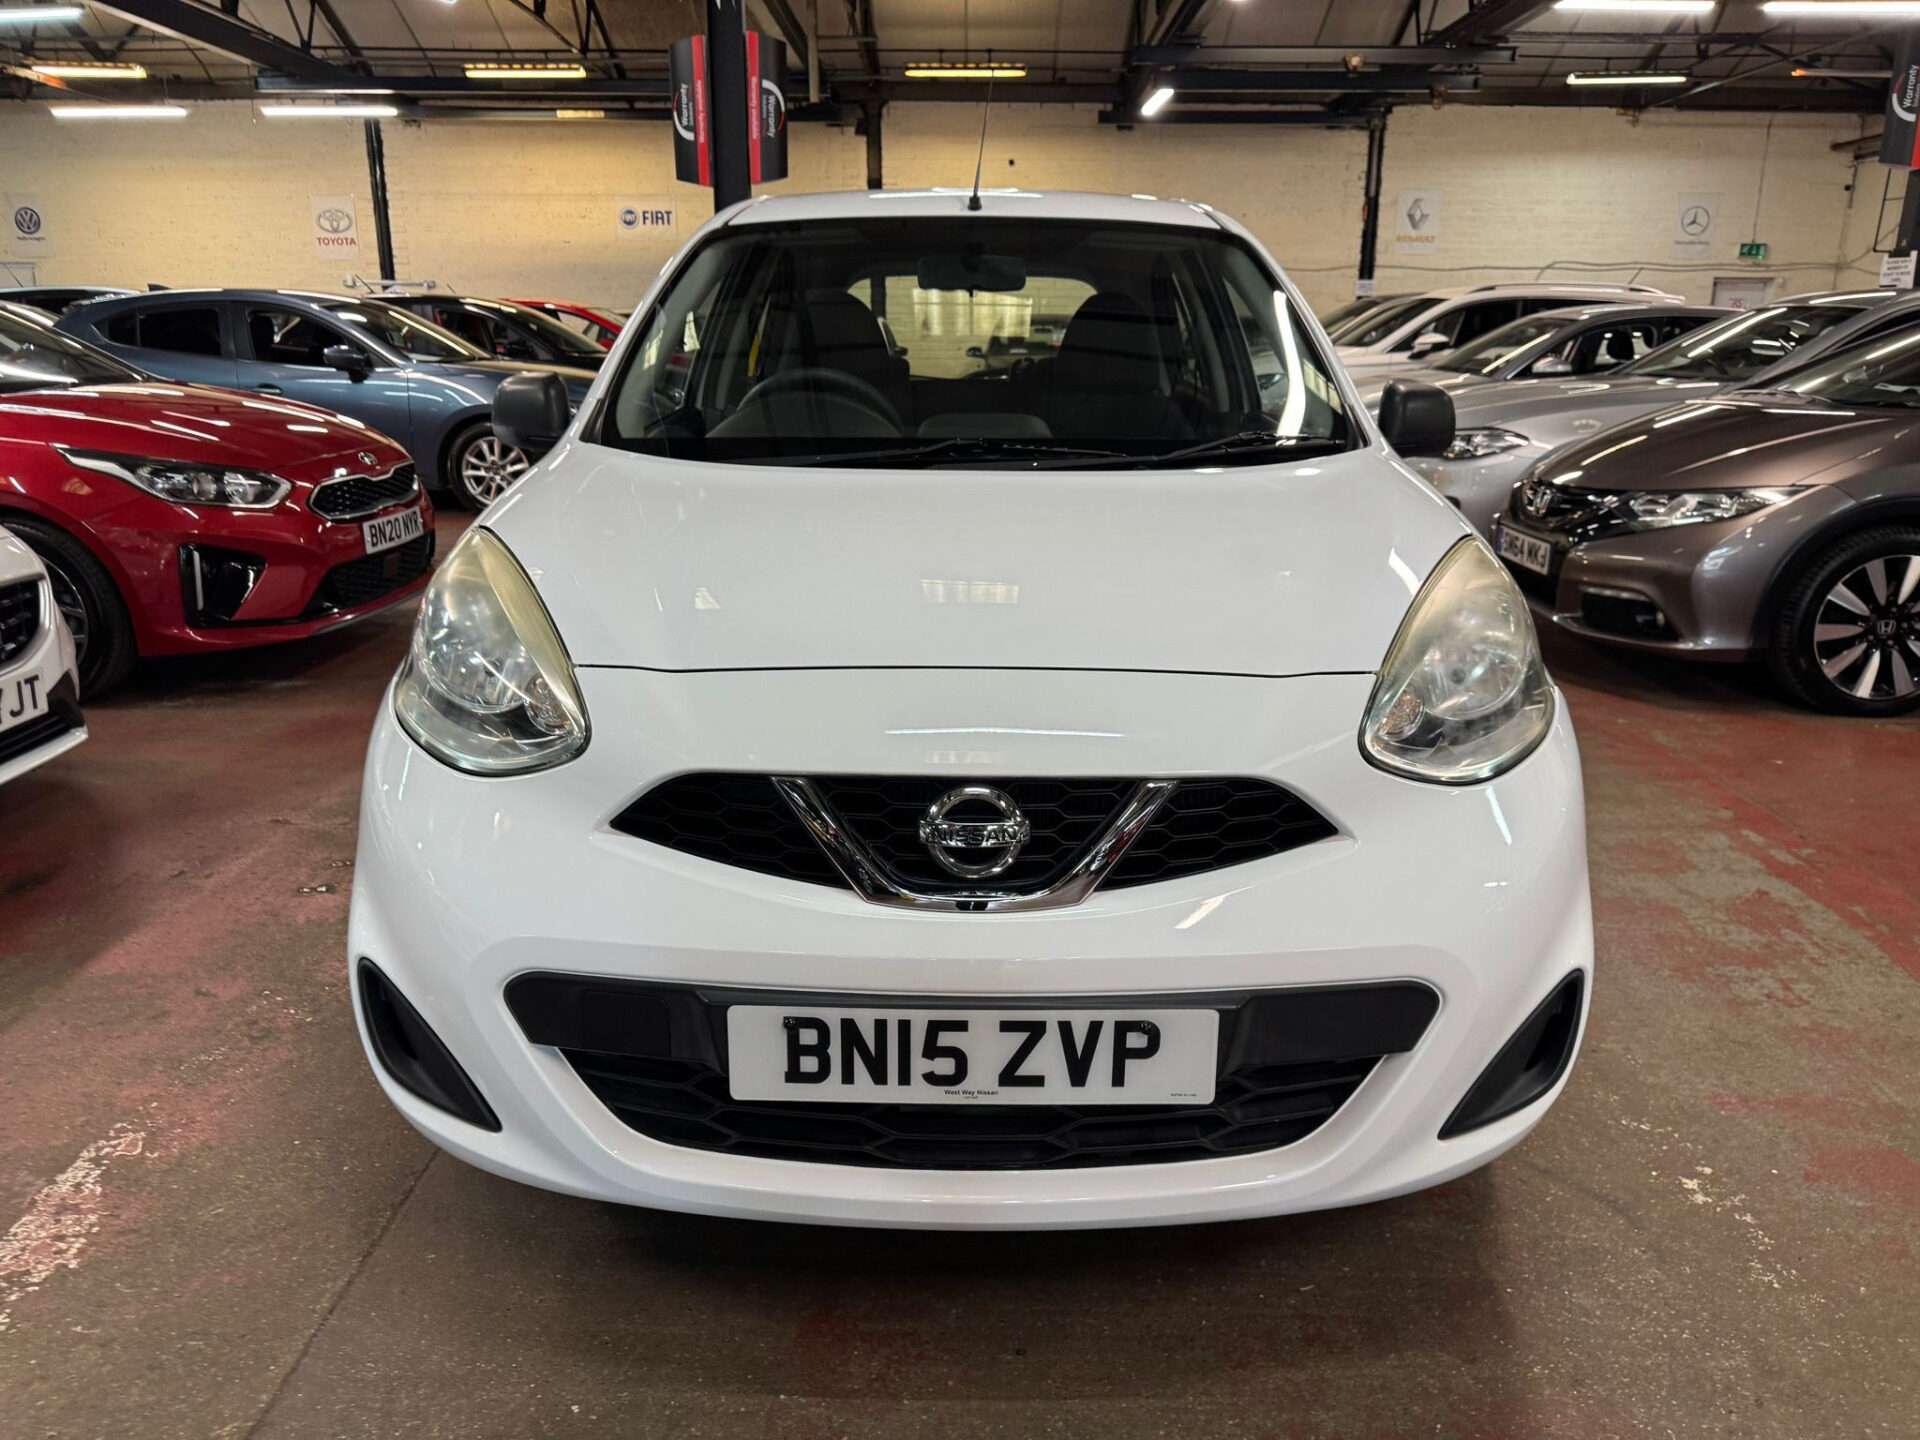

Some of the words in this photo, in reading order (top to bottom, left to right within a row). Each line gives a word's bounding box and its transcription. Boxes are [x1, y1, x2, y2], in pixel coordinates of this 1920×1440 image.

[680, 83, 688, 126] Warranty
[1903, 64, 1920, 108] Warranty
[768, 95, 776, 138] Warranty
[642, 210, 672, 225] FIAT
[317, 237, 356, 246] TOYOTA
[368, 517, 402, 548] BN20
[0, 674, 40, 725] JT
[926, 824, 1024, 846] NISSAN
[782, 1015, 969, 1086] BN15
[997, 1019, 1161, 1088] ZVP
[961, 1089, 976, 1097] Way
